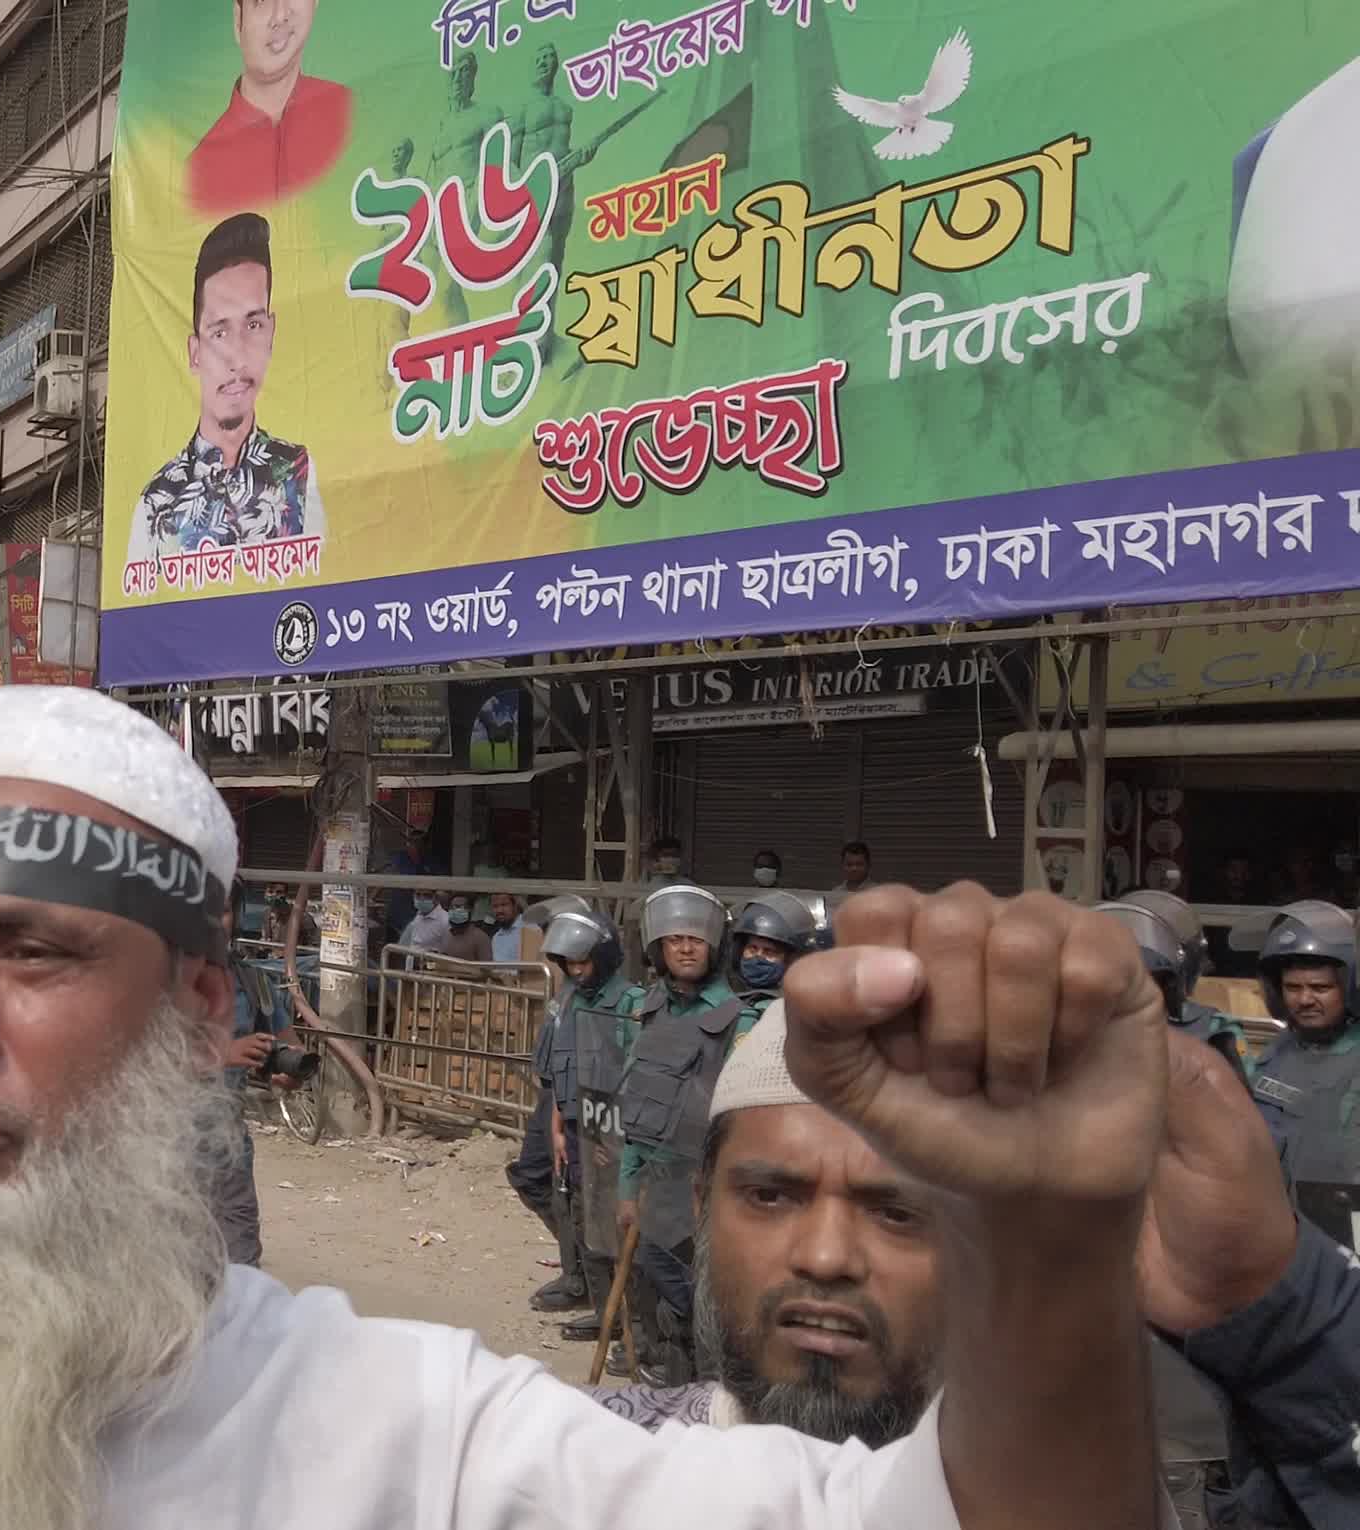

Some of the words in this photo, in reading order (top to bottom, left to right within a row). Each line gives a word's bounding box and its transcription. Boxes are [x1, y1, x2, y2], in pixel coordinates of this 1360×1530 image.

[566, 0, 744, 99] ভাইয়ের
[348, 121, 558, 313] ২৬
[565, 133, 1090, 367] স্বাধীনতা
[584, 153, 728, 242] মহান
[387, 262, 558, 443] মার্চ
[886, 272, 1150, 378] দিবসের
[535, 358, 850, 515] শুভেচ্ছা
[123, 558, 159, 597] মোঃ
[161, 539, 240, 587] তানভির
[242, 535, 321, 580] আহমেদ
[324, 607, 366, 647] ১৩
[375, 600, 412, 642] নং
[425, 571, 517, 640] ওয়ার্ড,
[535, 567, 631, 623] পল্টন
[643, 557, 727, 615] থানা
[737, 528, 918, 608] ছাত্রলীগ,
[939, 517, 1062, 586] ঢাকা
[1073, 490, 1324, 574] মহানগর
[570, 669, 733, 714] VEUS
[751, 667, 882, 702] INTRIOR
[895, 657, 997, 691] TRADE
[582, 1097, 625, 1137] POL
